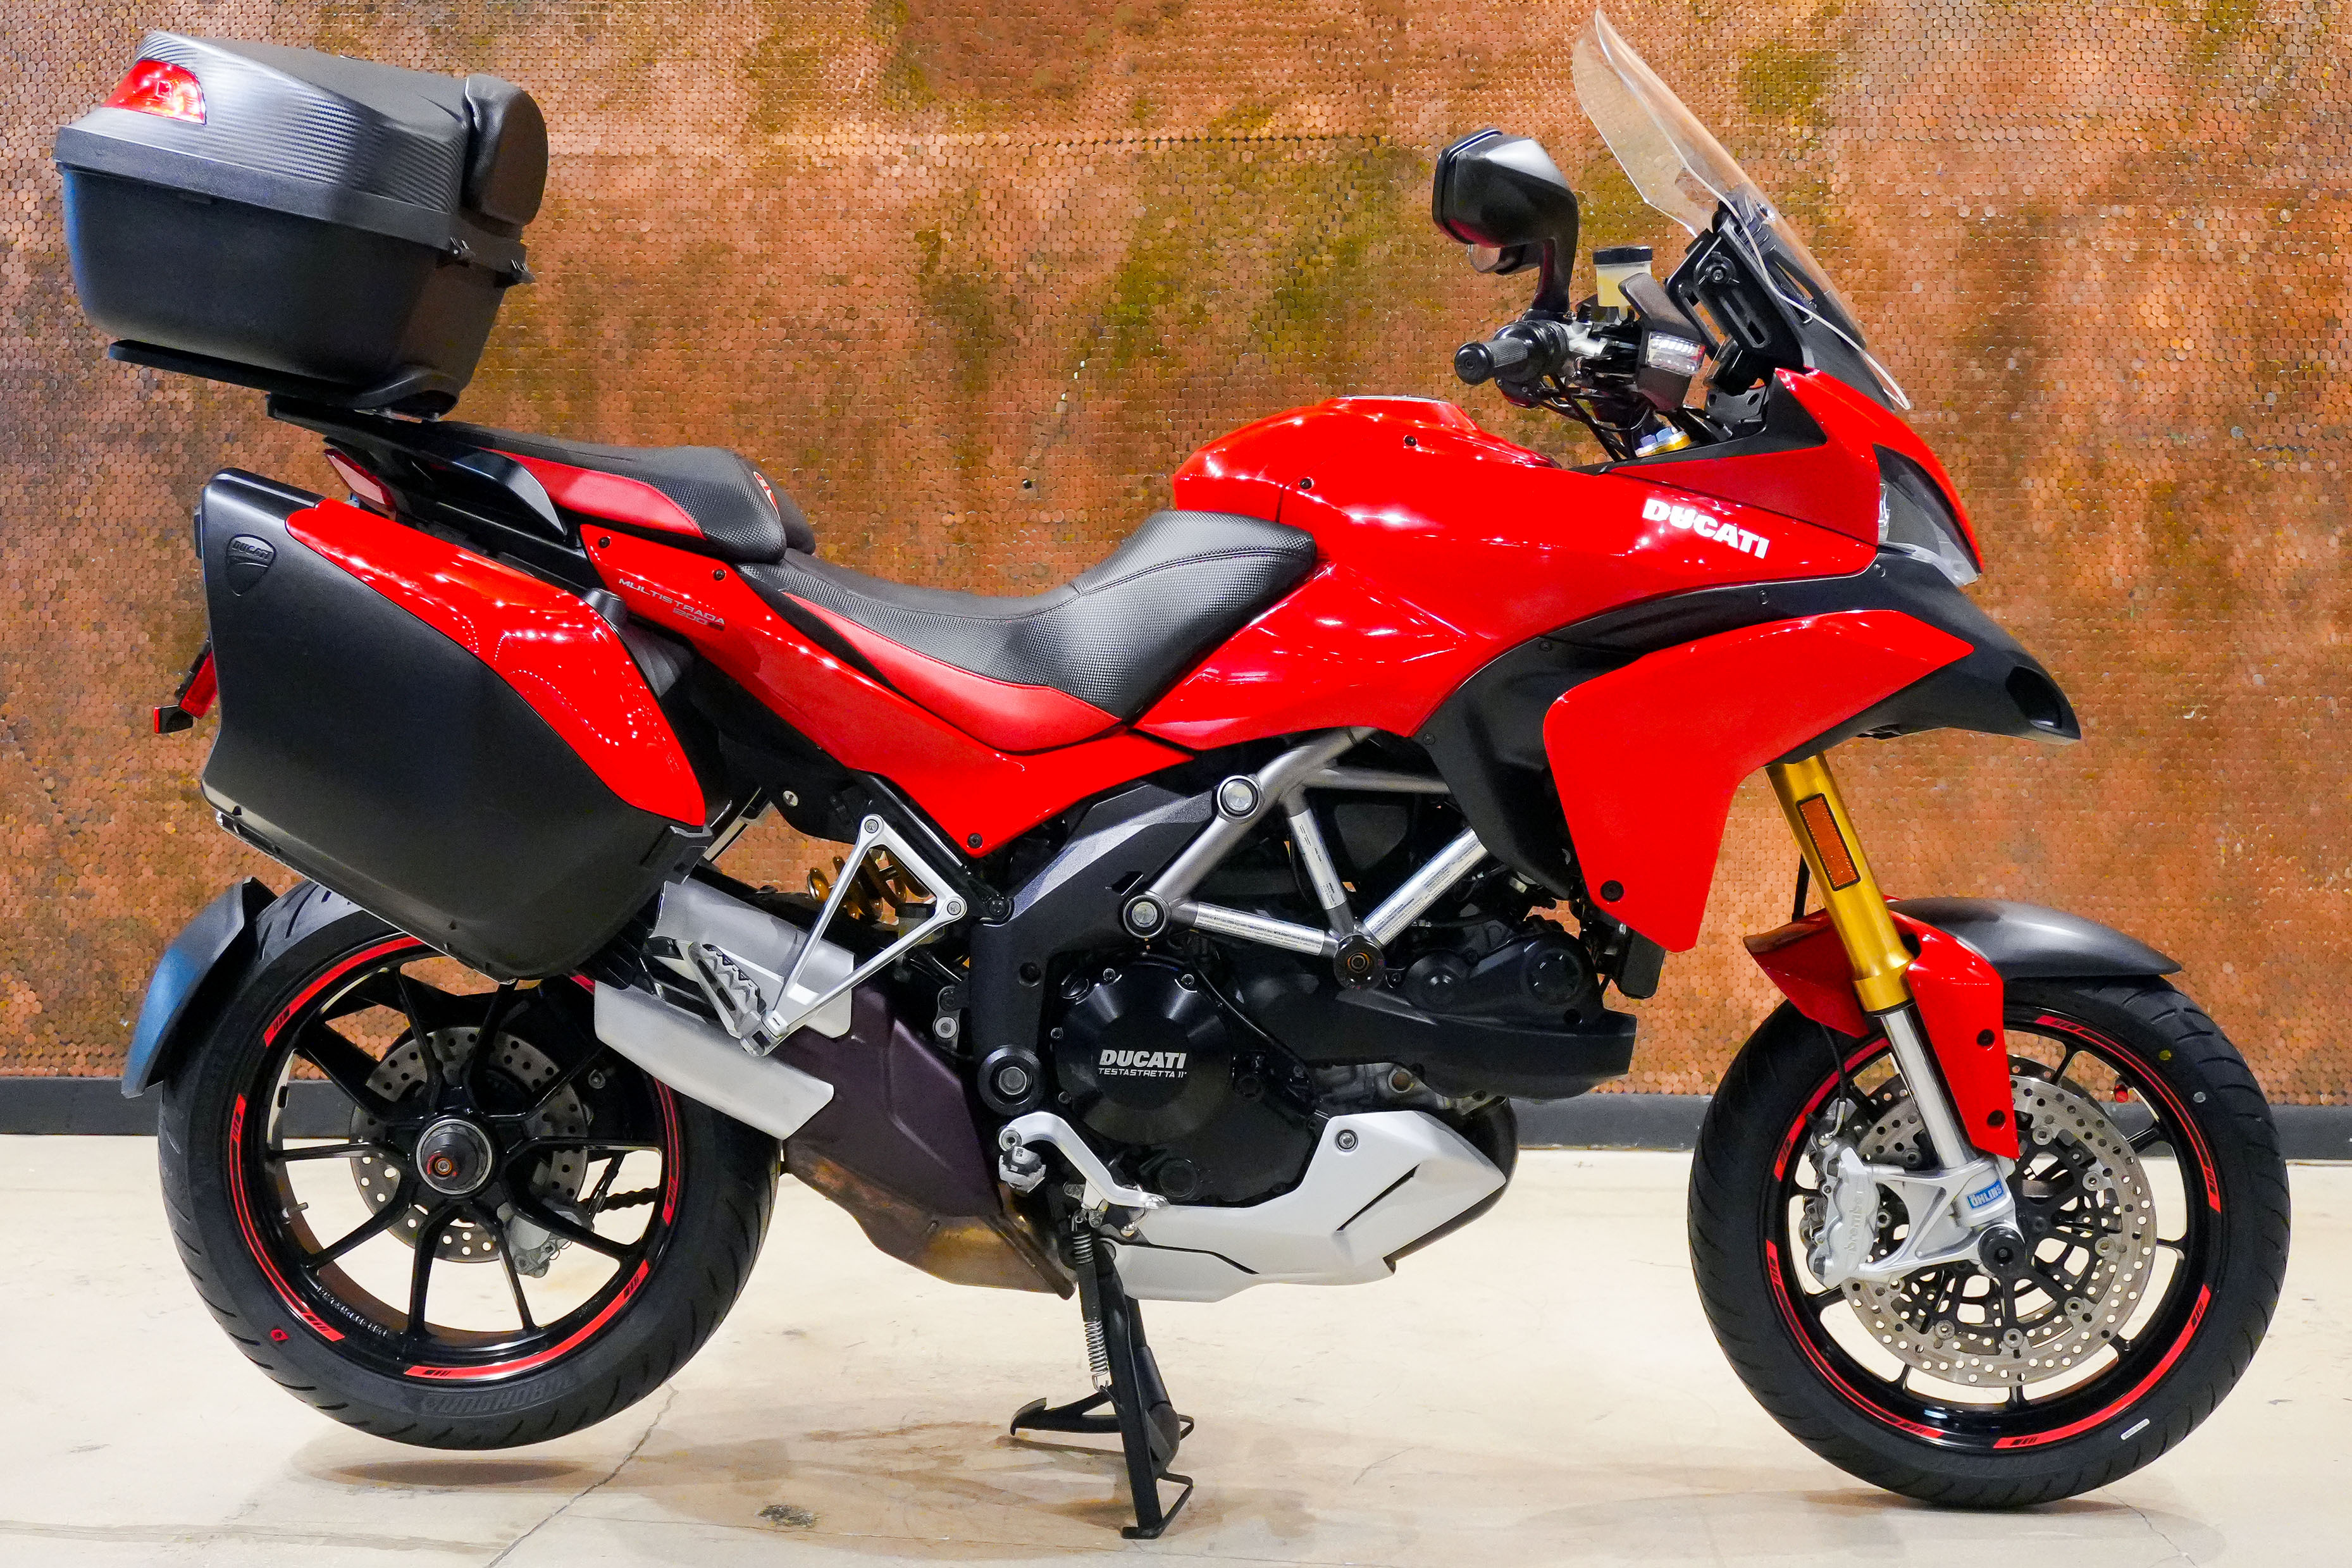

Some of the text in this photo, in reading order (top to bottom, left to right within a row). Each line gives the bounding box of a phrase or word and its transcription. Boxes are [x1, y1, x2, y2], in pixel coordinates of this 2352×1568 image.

[1642, 498, 1770, 559] DUCATI
[232, 540, 273, 560] DUCATI
[619, 578, 726, 625] MULTISTRADA
[672, 607, 709, 626] 1200
[1099, 1049, 1187, 1069] DUCATI
[1098, 1067, 1175, 1078] TESTASTRETTA
